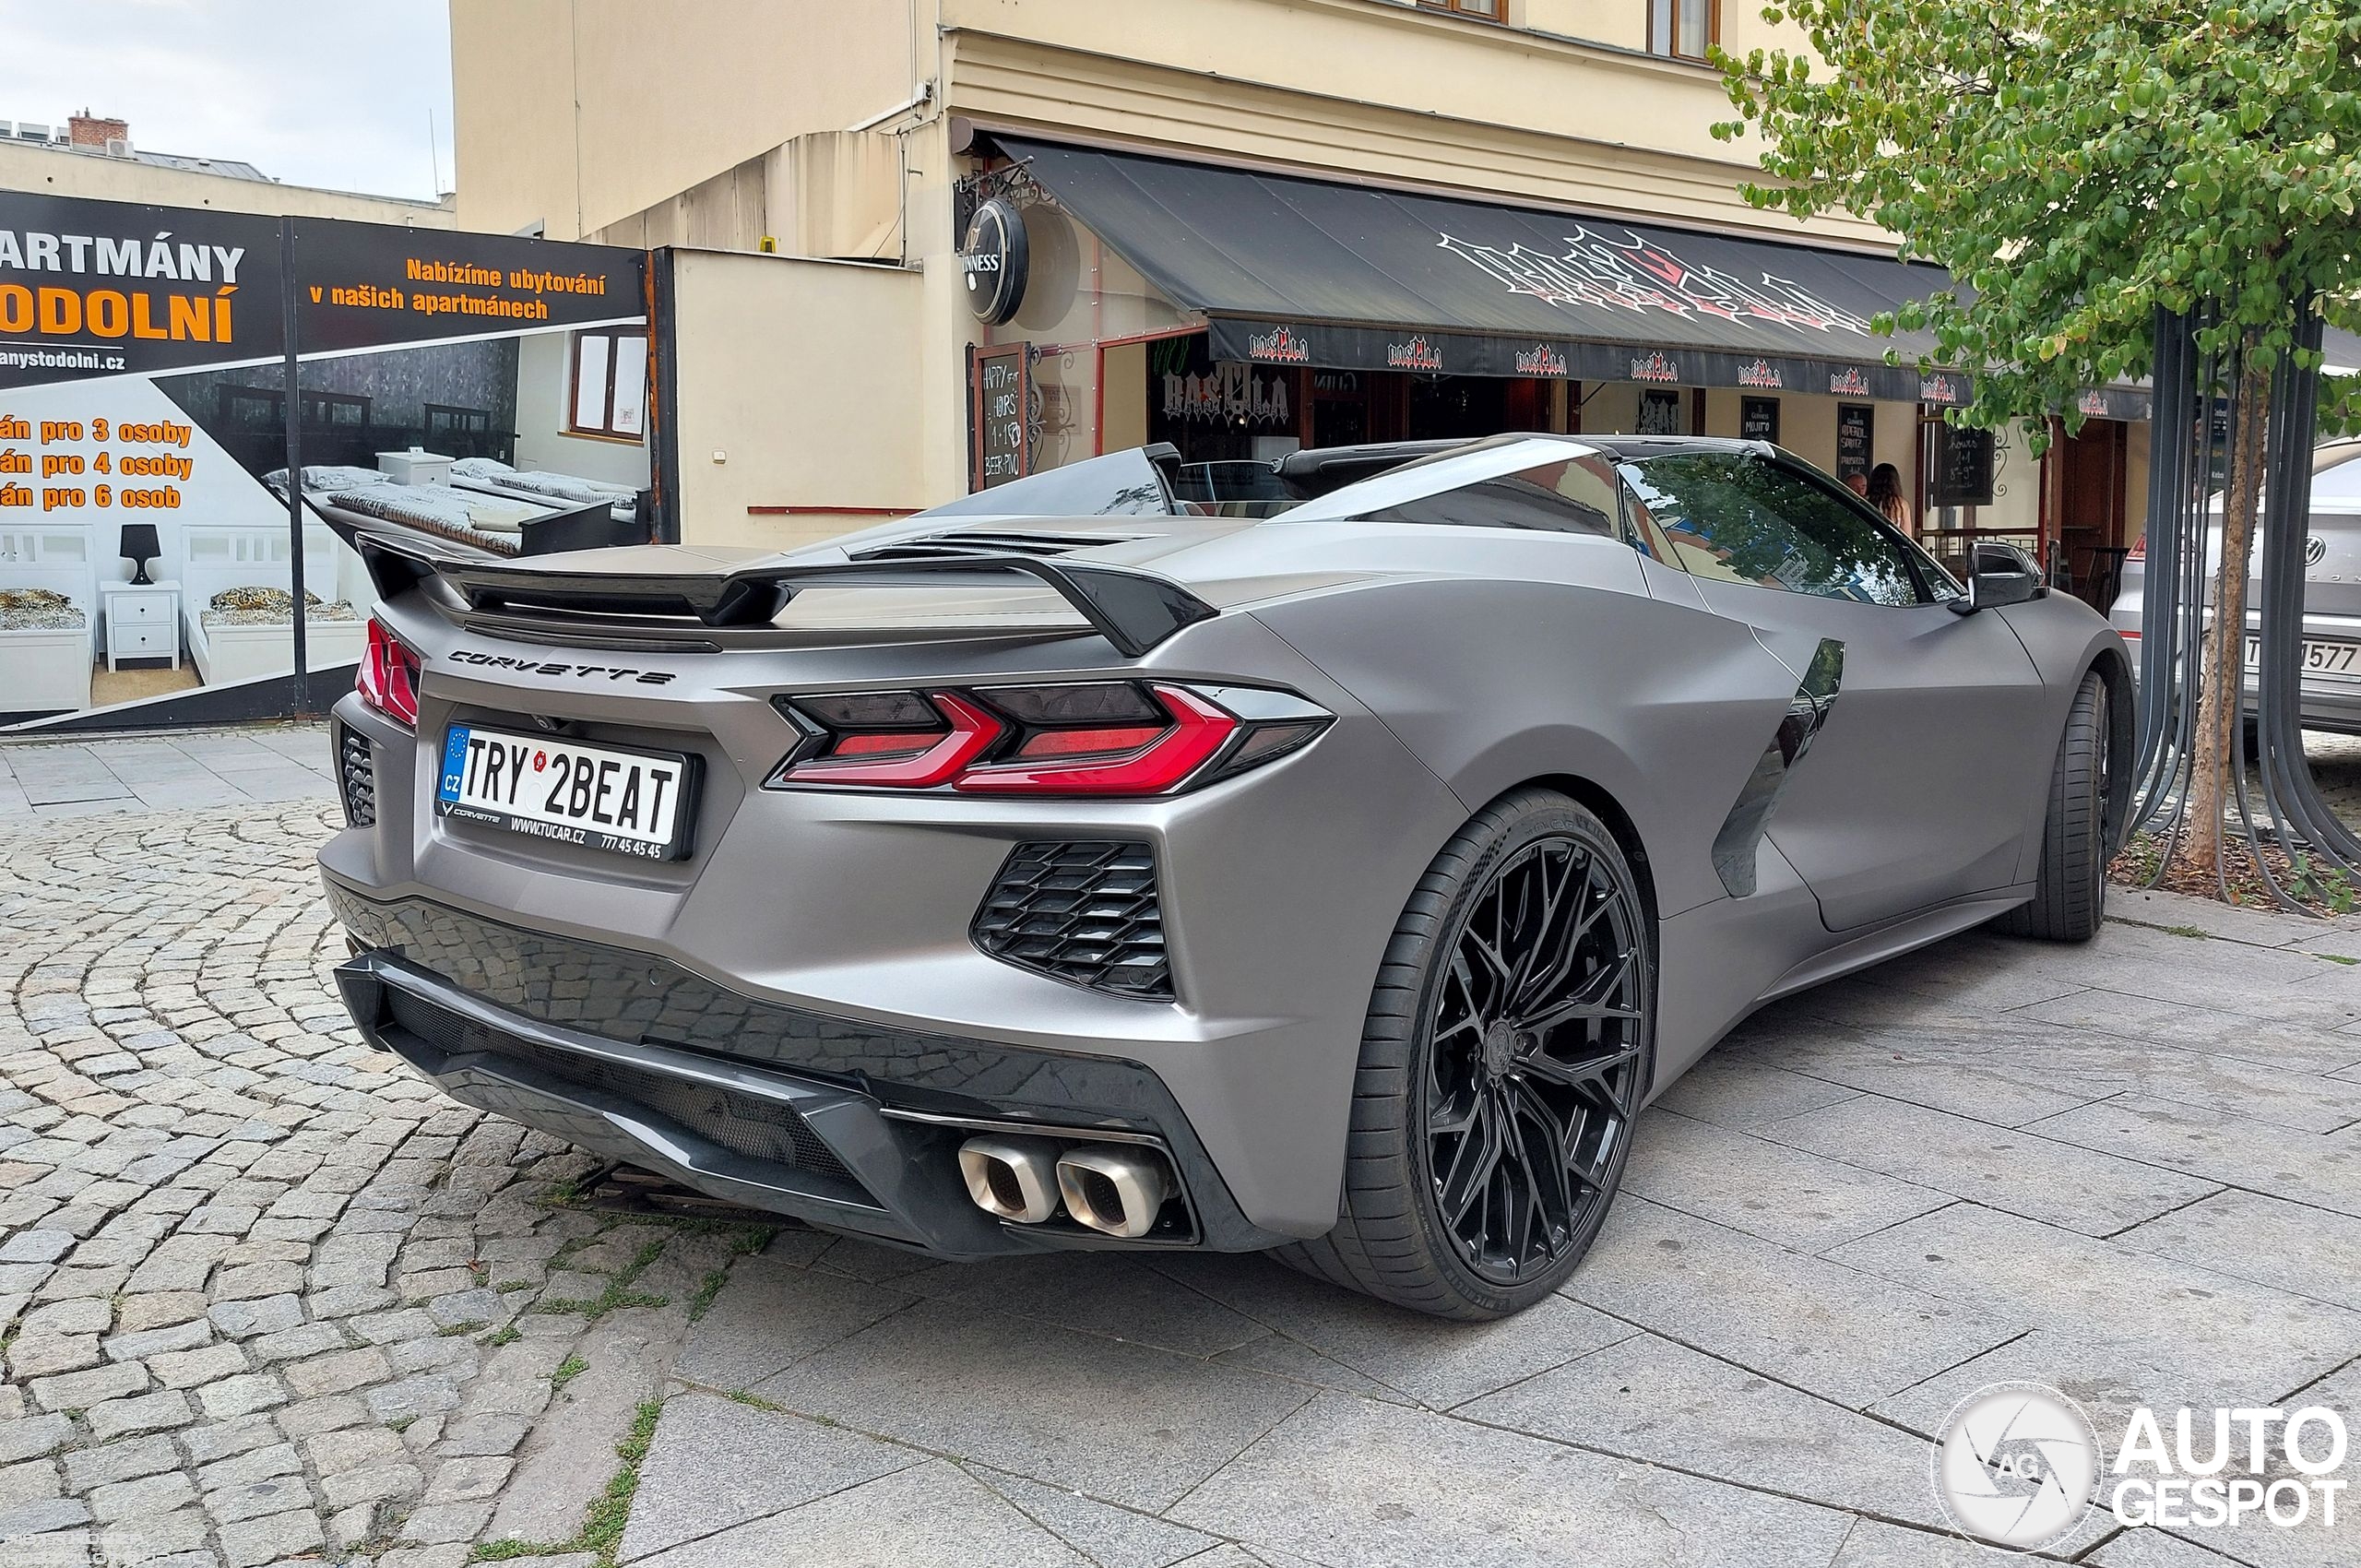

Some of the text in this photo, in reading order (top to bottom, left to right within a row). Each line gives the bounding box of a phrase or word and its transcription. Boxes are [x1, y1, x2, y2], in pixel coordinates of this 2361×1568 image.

[406, 258, 606, 295] Nabízíme ubytování
[309, 284, 548, 320] v našich apartmánech
[41, 422, 83, 445] pro
[92, 418, 110, 442] 3
[119, 421, 192, 448] osoby
[1746, 422, 1770, 434] MOJITO
[42, 456, 85, 479] pro
[93, 452, 111, 475] 4
[120, 453, 193, 481] osoby
[43, 488, 86, 511] pro
[95, 484, 112, 507] 6
[121, 485, 181, 508] osob
[448, 650, 677, 684] CORVETTE
[445, 774, 460, 793] CZ
[467, 738, 673, 834] TRY 2BEAT
[453, 808, 501, 824] CORVETTE
[511, 817, 661, 859] WWW.TUCAR.CZ 777 45 45 45
